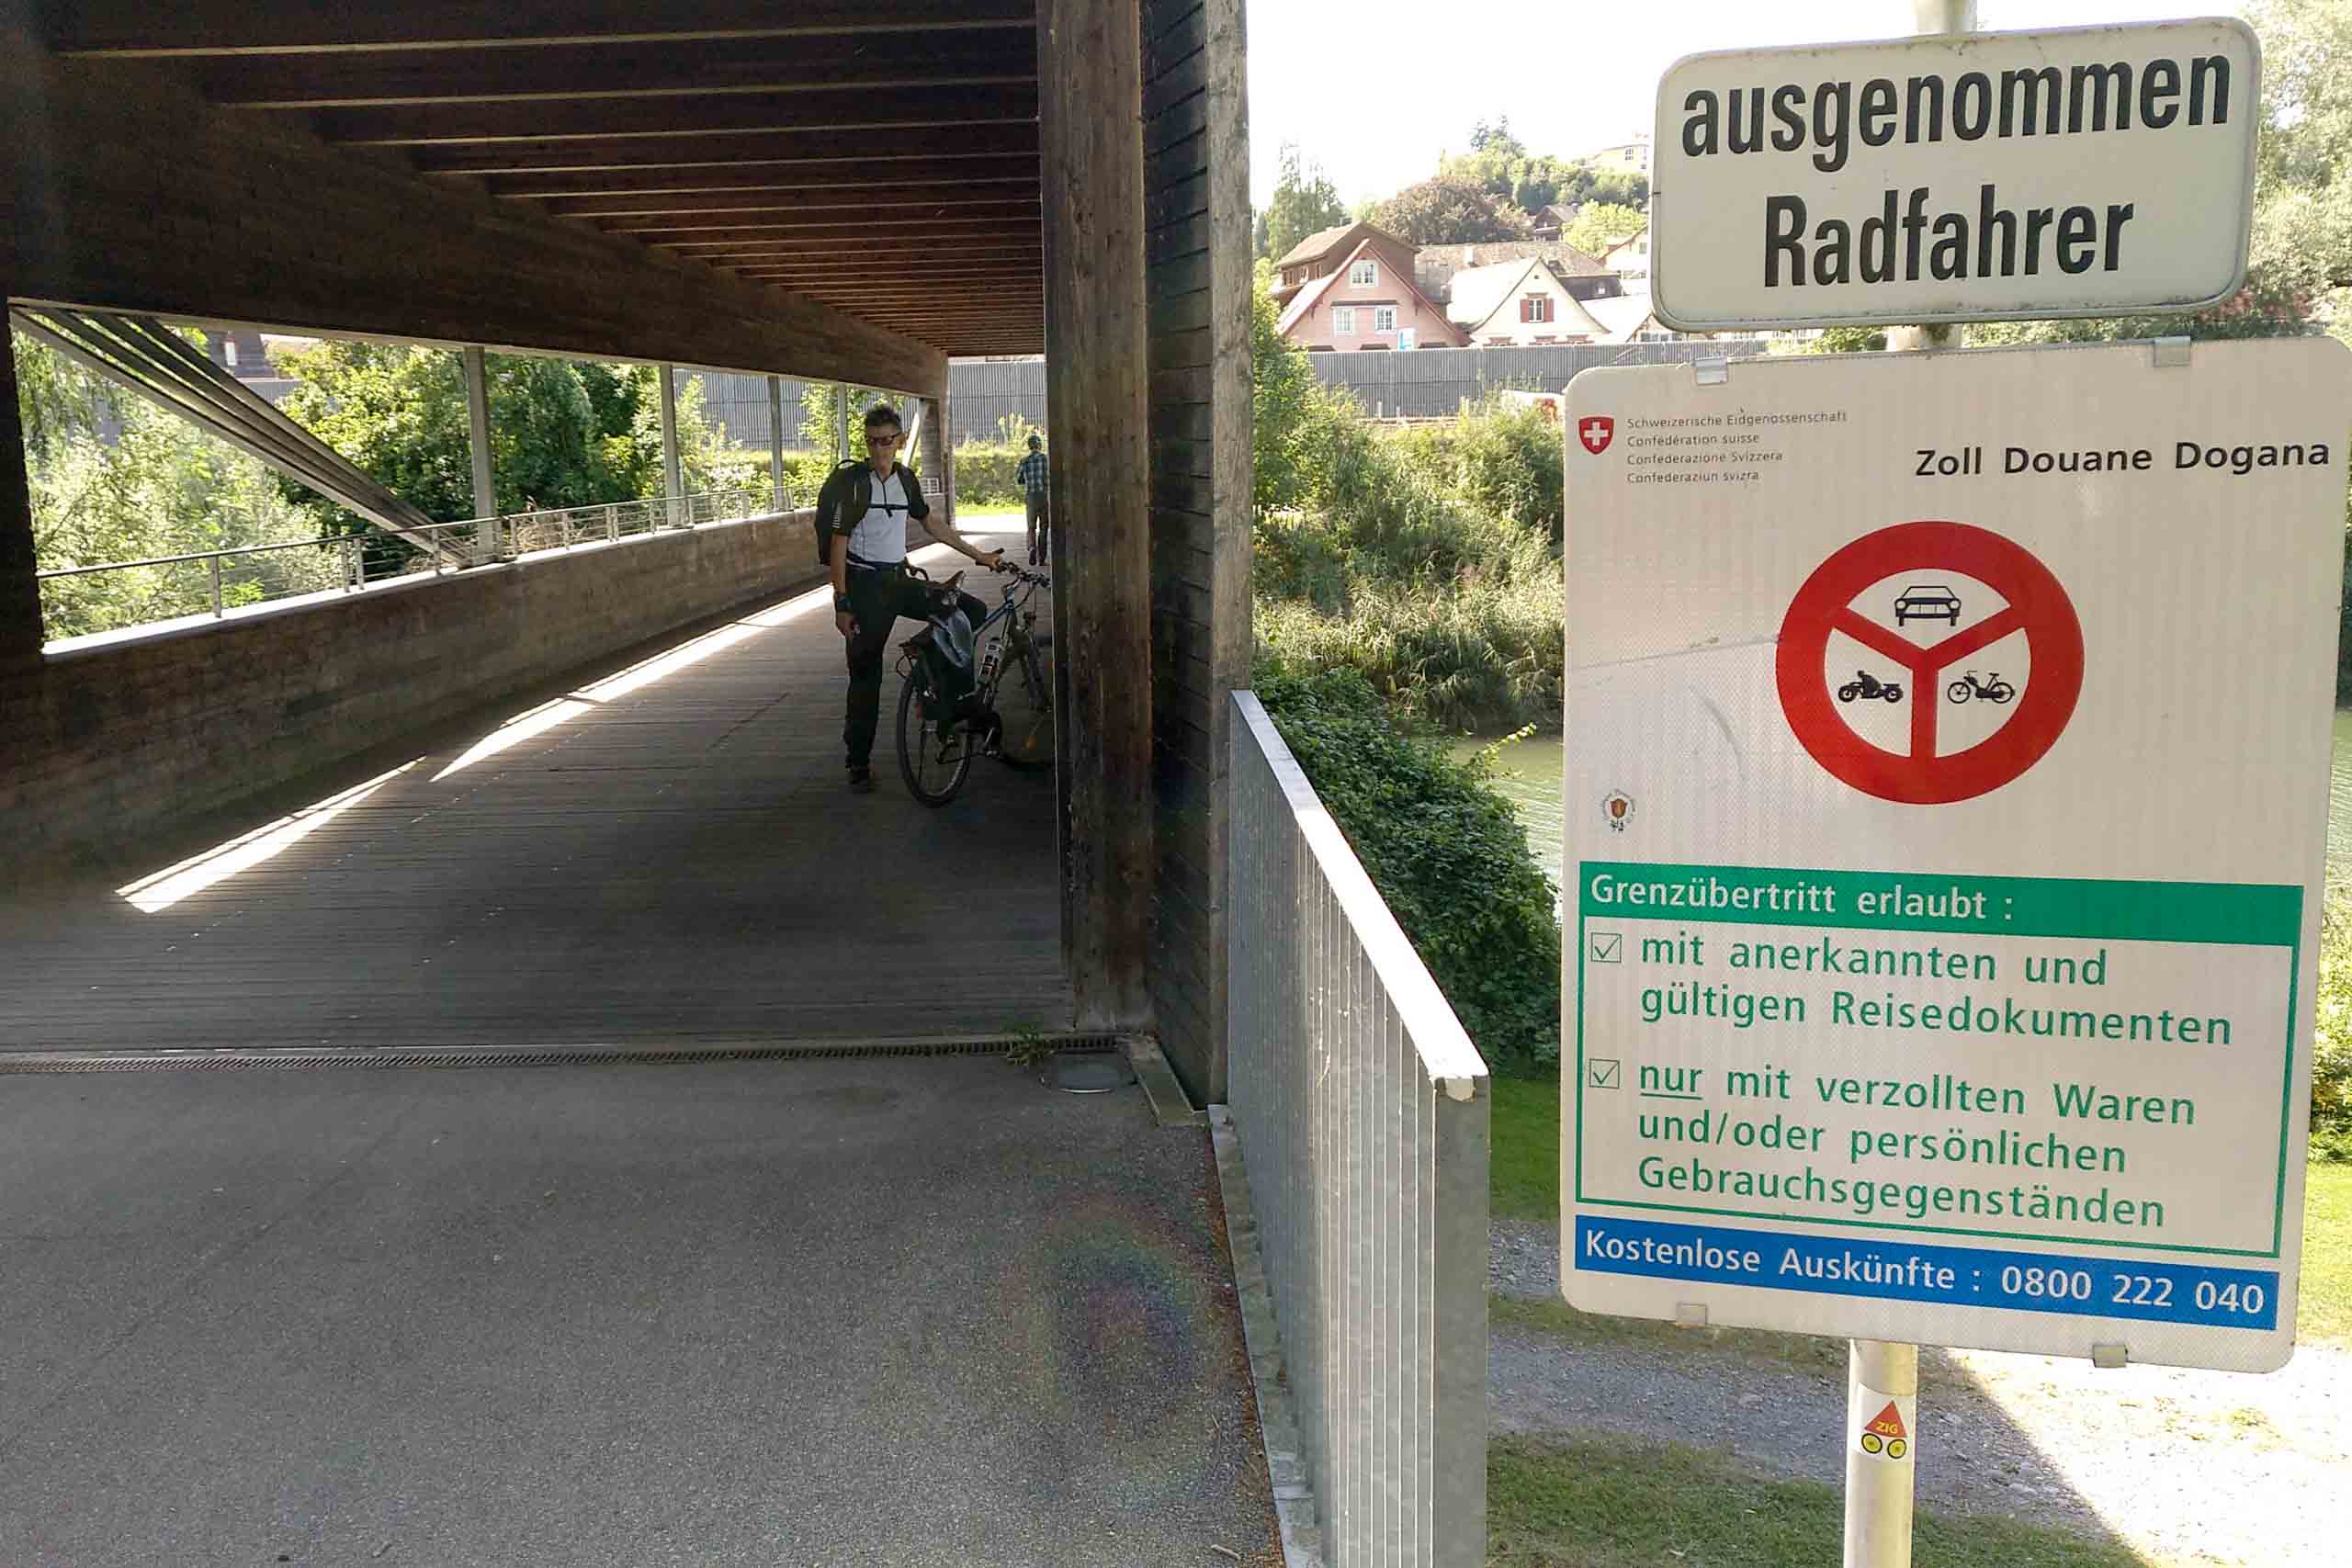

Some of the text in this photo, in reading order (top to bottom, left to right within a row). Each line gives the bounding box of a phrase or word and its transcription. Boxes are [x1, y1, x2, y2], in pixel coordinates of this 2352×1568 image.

[1682, 52, 2231, 173] ausgenommen
[1764, 184, 2134, 288] Radfahrer
[1627, 411, 1848, 429] Schweizerische Eidgenossenschaft
[1722, 433, 1759, 445] suisse
[1627, 450, 1783, 466] Confederazione Svizzera
[1627, 472, 1719, 484] Confederaziun
[1916, 442, 2330, 477] Zoll Douane Dogana
[1590, 875, 2014, 920] Grenzübertritt erlaubt :
[1642, 931, 2108, 986] mit anerkannten und
[1641, 981, 2231, 1045] gültigen Reisedokumenten
[1640, 1064, 2196, 1125] nur mit verzollten Waren
[1639, 1109, 2126, 1173] und/oder persönlichen
[1638, 1156, 2165, 1227] Gebrauchsgegenständen
[1585, 1229, 2266, 1314] Kostenlose Auskünfte : 0800 222 040
